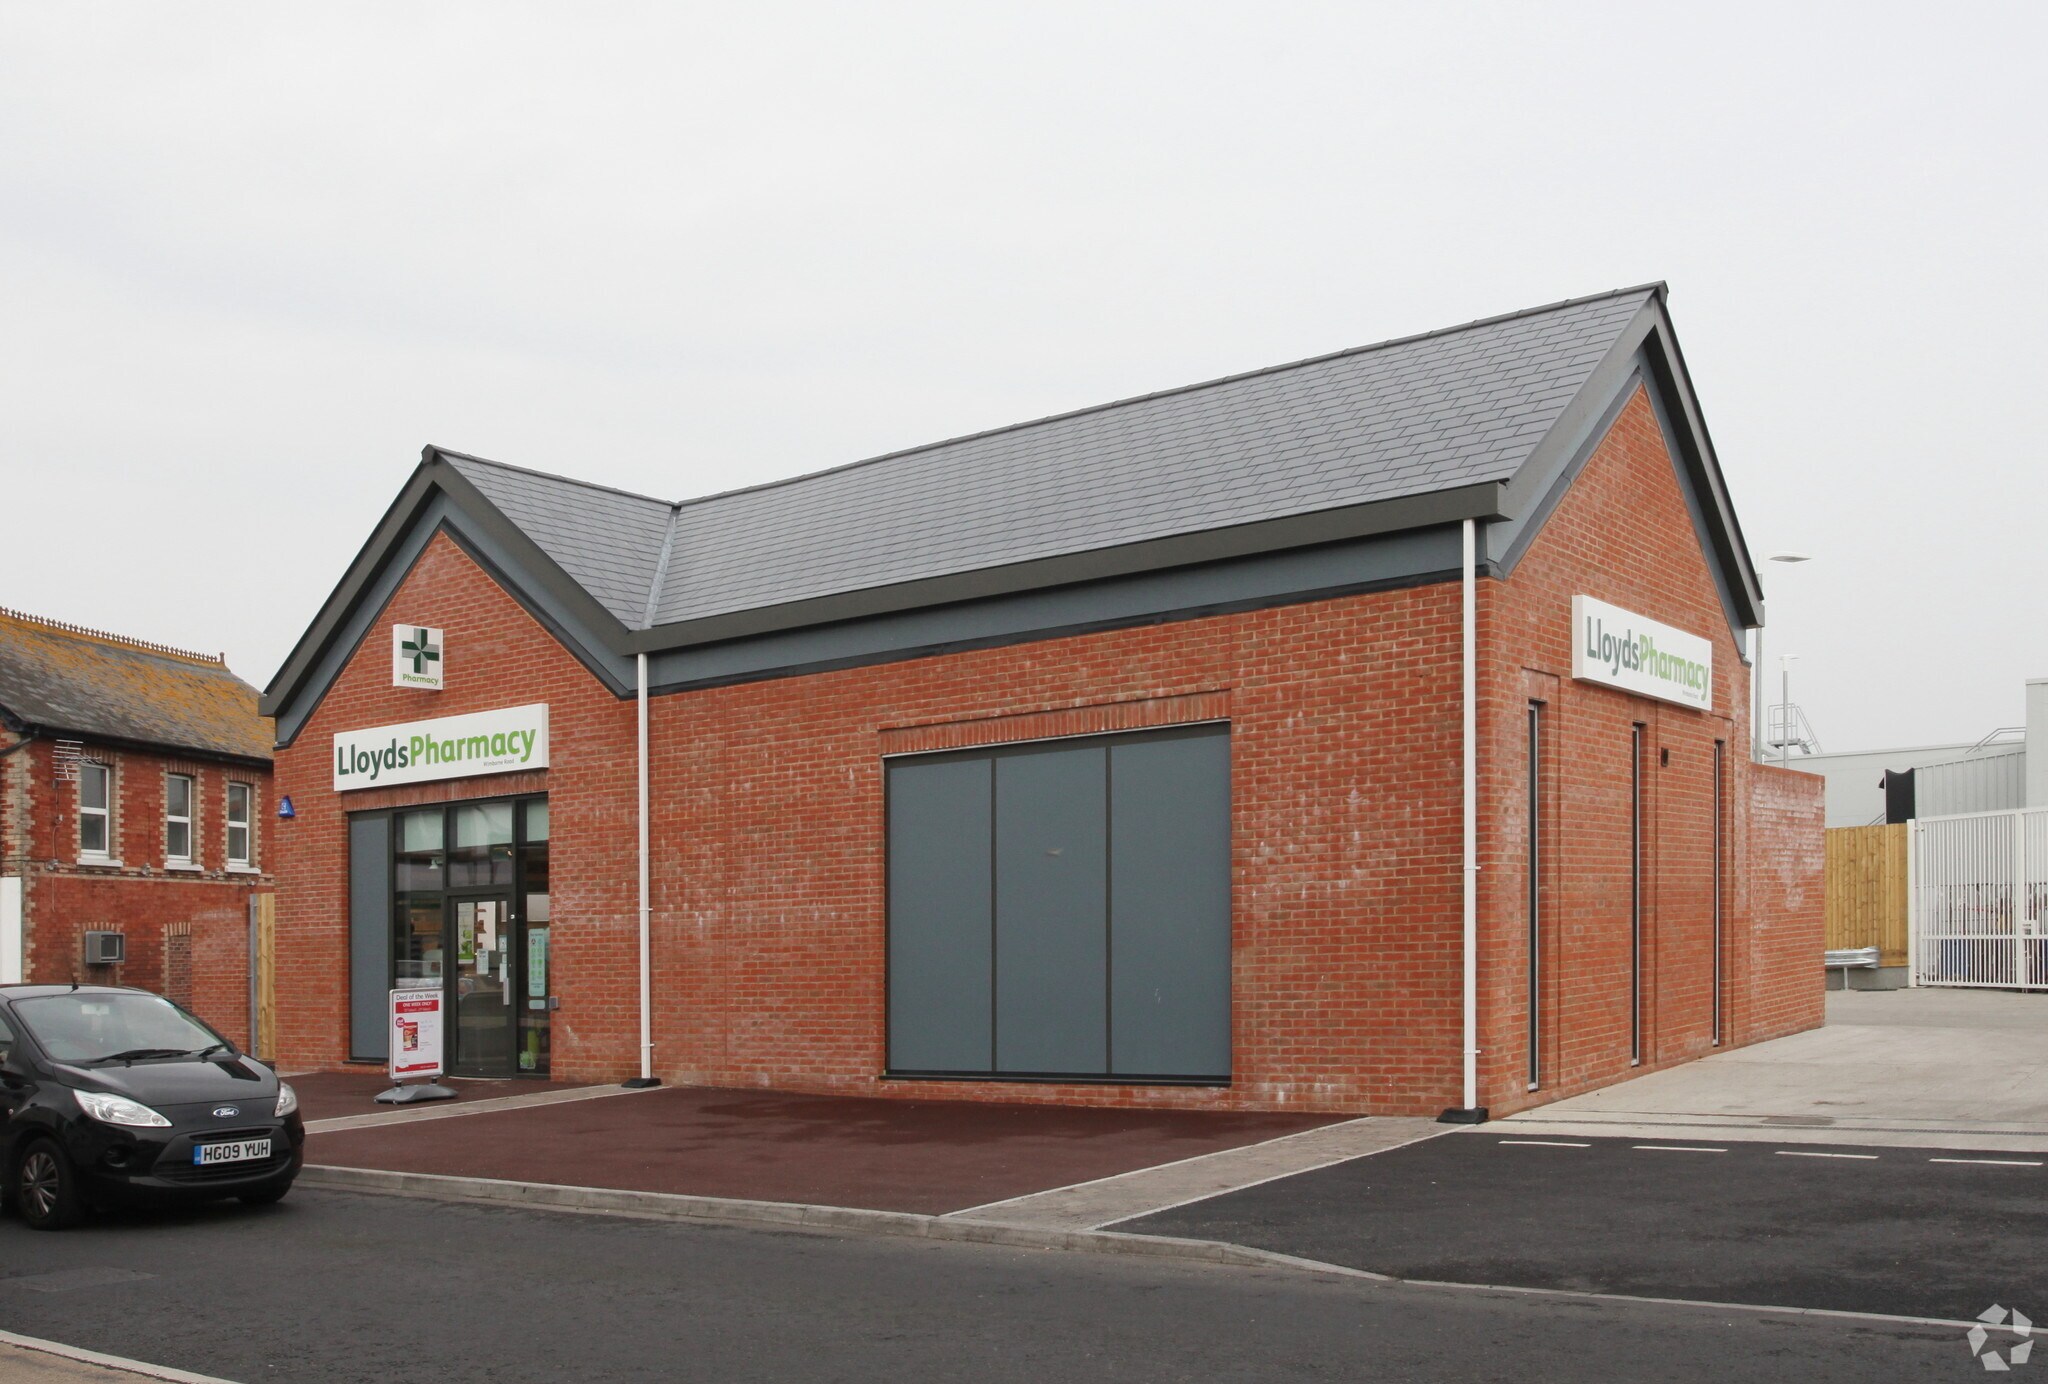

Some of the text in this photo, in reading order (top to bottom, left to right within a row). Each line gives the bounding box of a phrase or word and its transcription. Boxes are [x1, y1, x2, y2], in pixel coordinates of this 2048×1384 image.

[1587, 616, 1709, 701] LloydsPharmacy
[402, 673, 439, 686] Pharmacy
[338, 729, 537, 780] LloydsPharmacy
[204, 1141, 268, 1161] HG09 YUH
